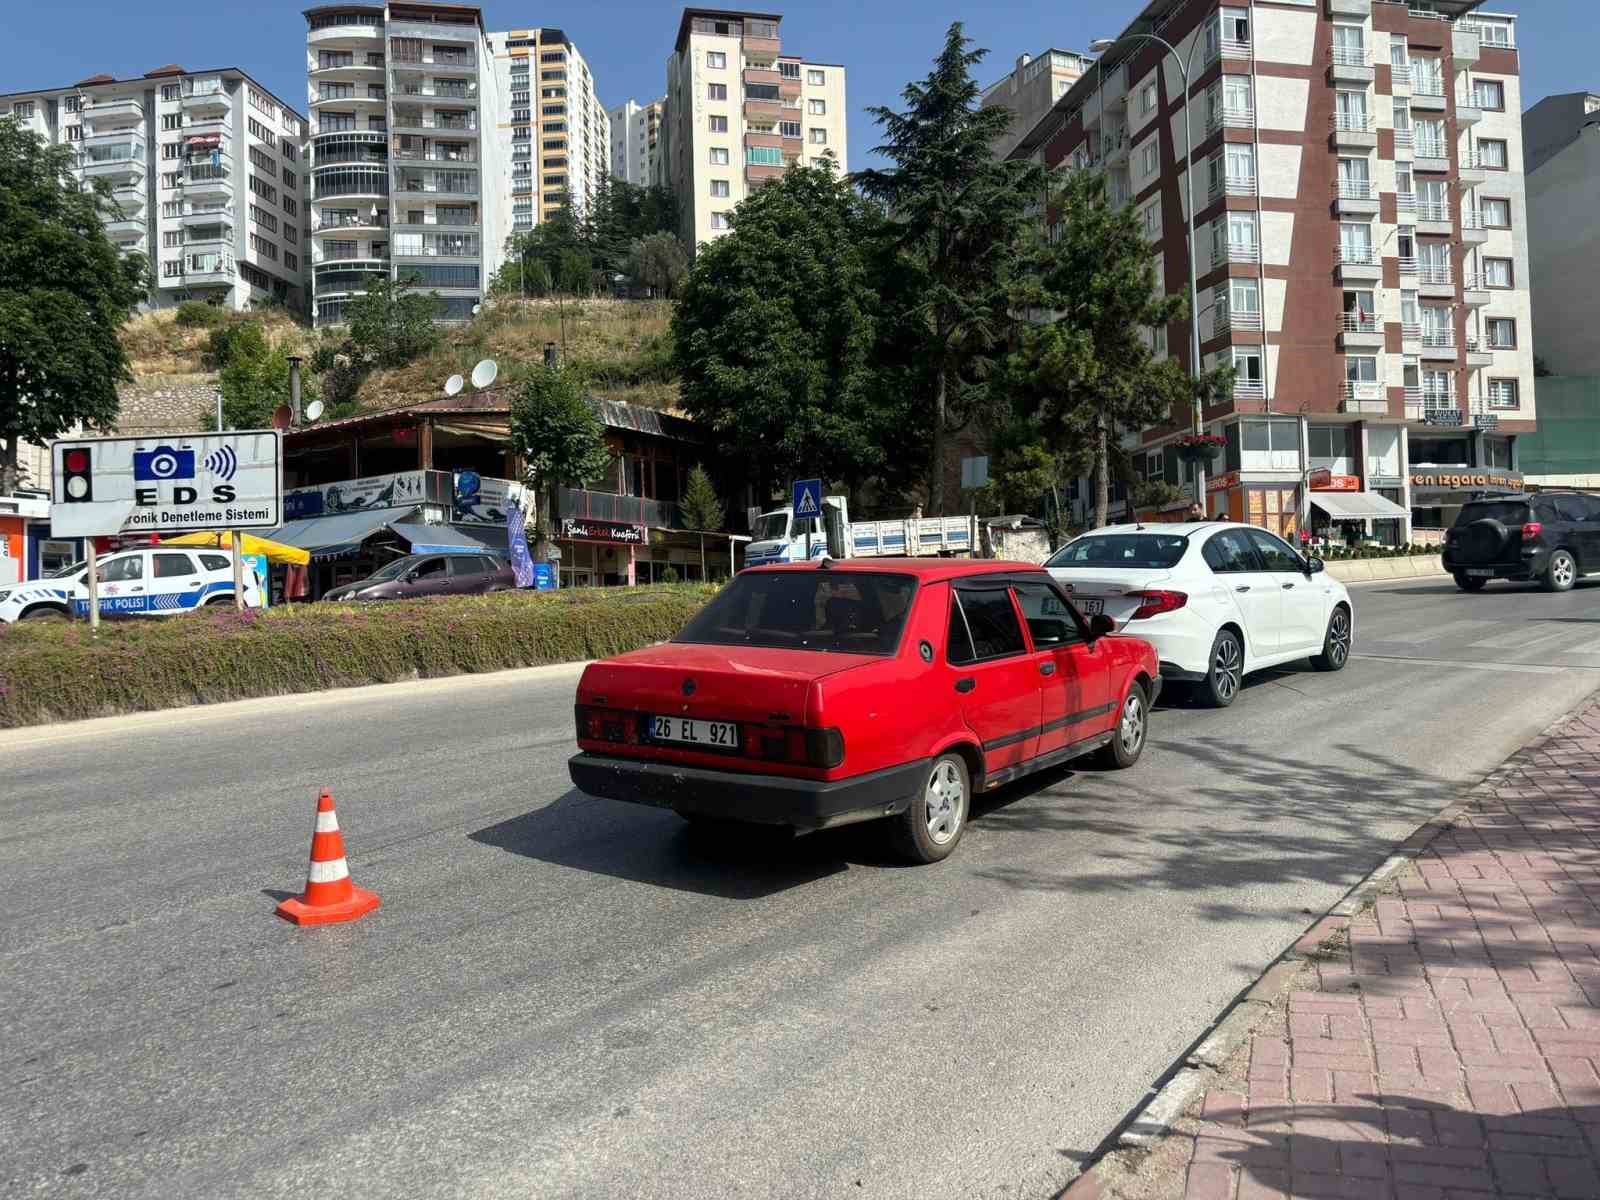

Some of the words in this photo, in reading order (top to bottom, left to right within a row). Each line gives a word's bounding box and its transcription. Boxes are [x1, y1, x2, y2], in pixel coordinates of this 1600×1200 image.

[161, 510, 222, 523] Denetleme
[226, 507, 269, 520] Sistemi
[80, 600, 113, 611] TFİK
[656, 718, 671, 738] 26
[681, 720, 698, 740] EL
[710, 723, 735, 745] 921
